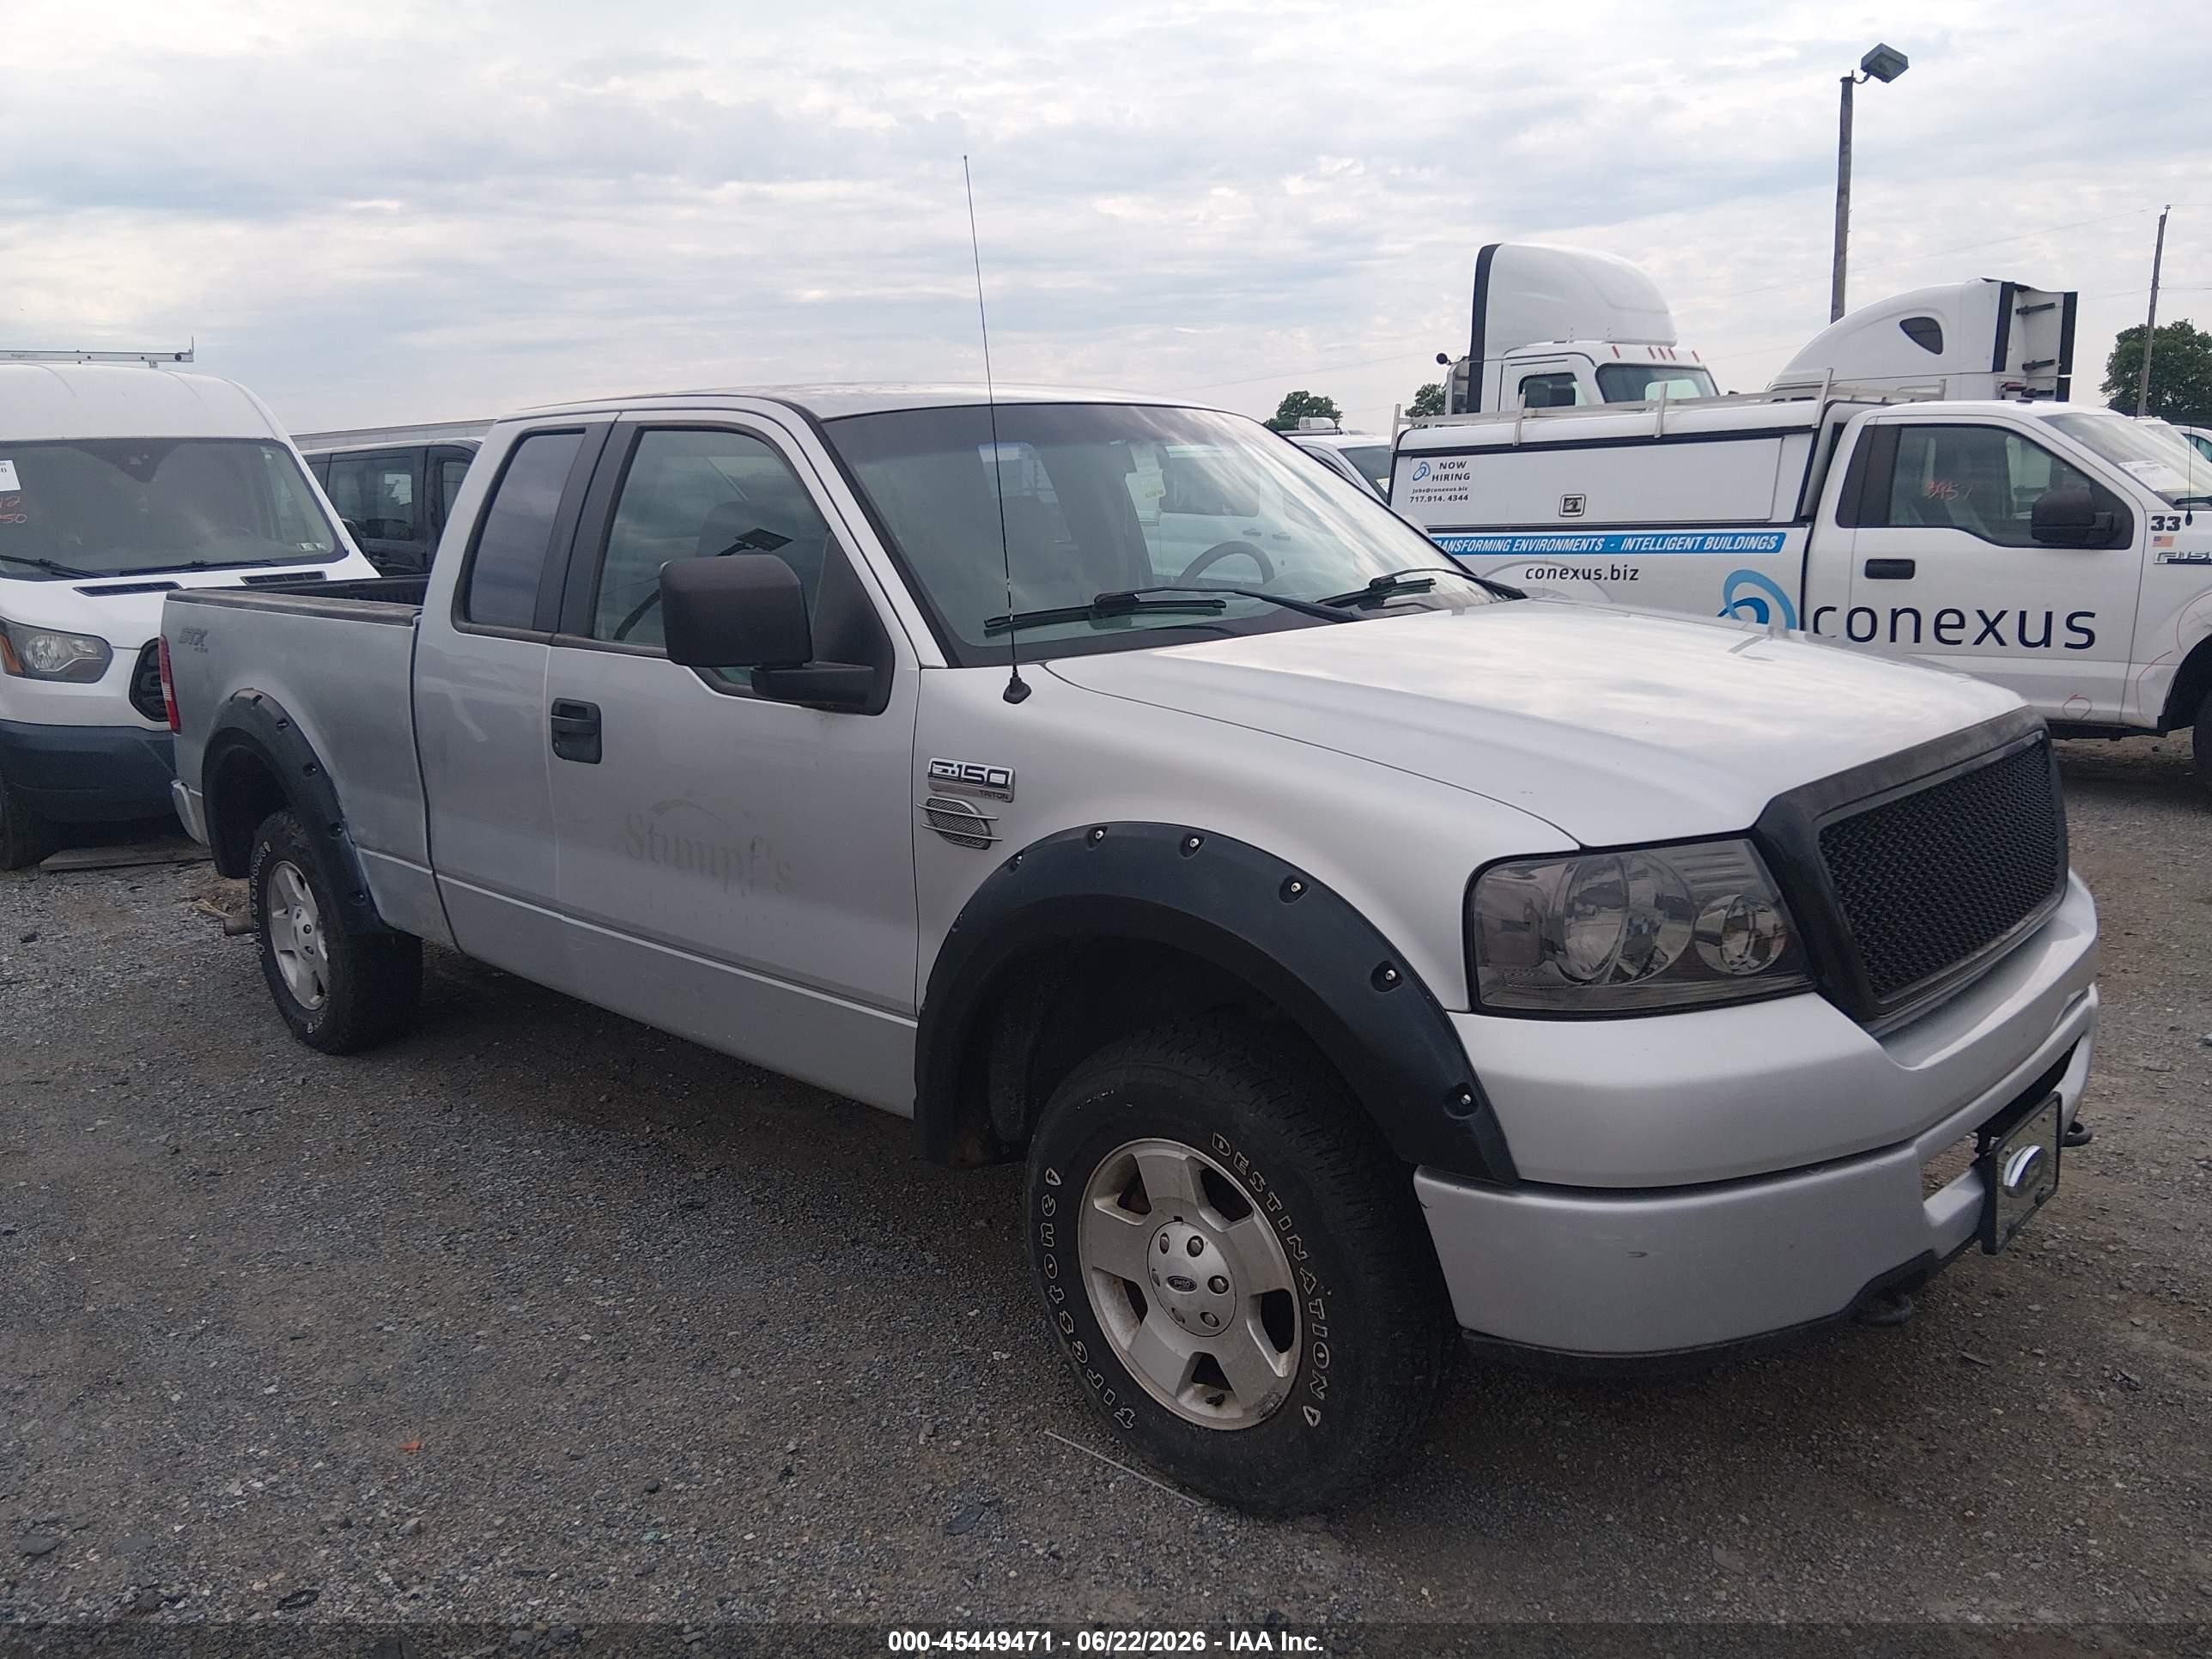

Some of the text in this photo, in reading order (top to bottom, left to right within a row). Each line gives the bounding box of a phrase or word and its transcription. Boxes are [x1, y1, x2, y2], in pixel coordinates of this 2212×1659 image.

[1439, 460, 1468, 470] NOW
[1431, 472, 1471, 482] HIRING
[2150, 515, 2182, 532] 33
[1435, 538, 1512, 552] ANSFORMING
[1512, 537, 1606, 552] ENVIRONMENTS
[1620, 536, 1705, 550] INTELLIGENT
[1704, 535, 1779, 550] BUILDINGS
[1525, 563, 1639, 581] conexus.biz
[1812, 605, 2097, 649] conexus
[979, 789, 1010, 801] TRITON
[1212, 1132, 1331, 1401] DESTINATION
